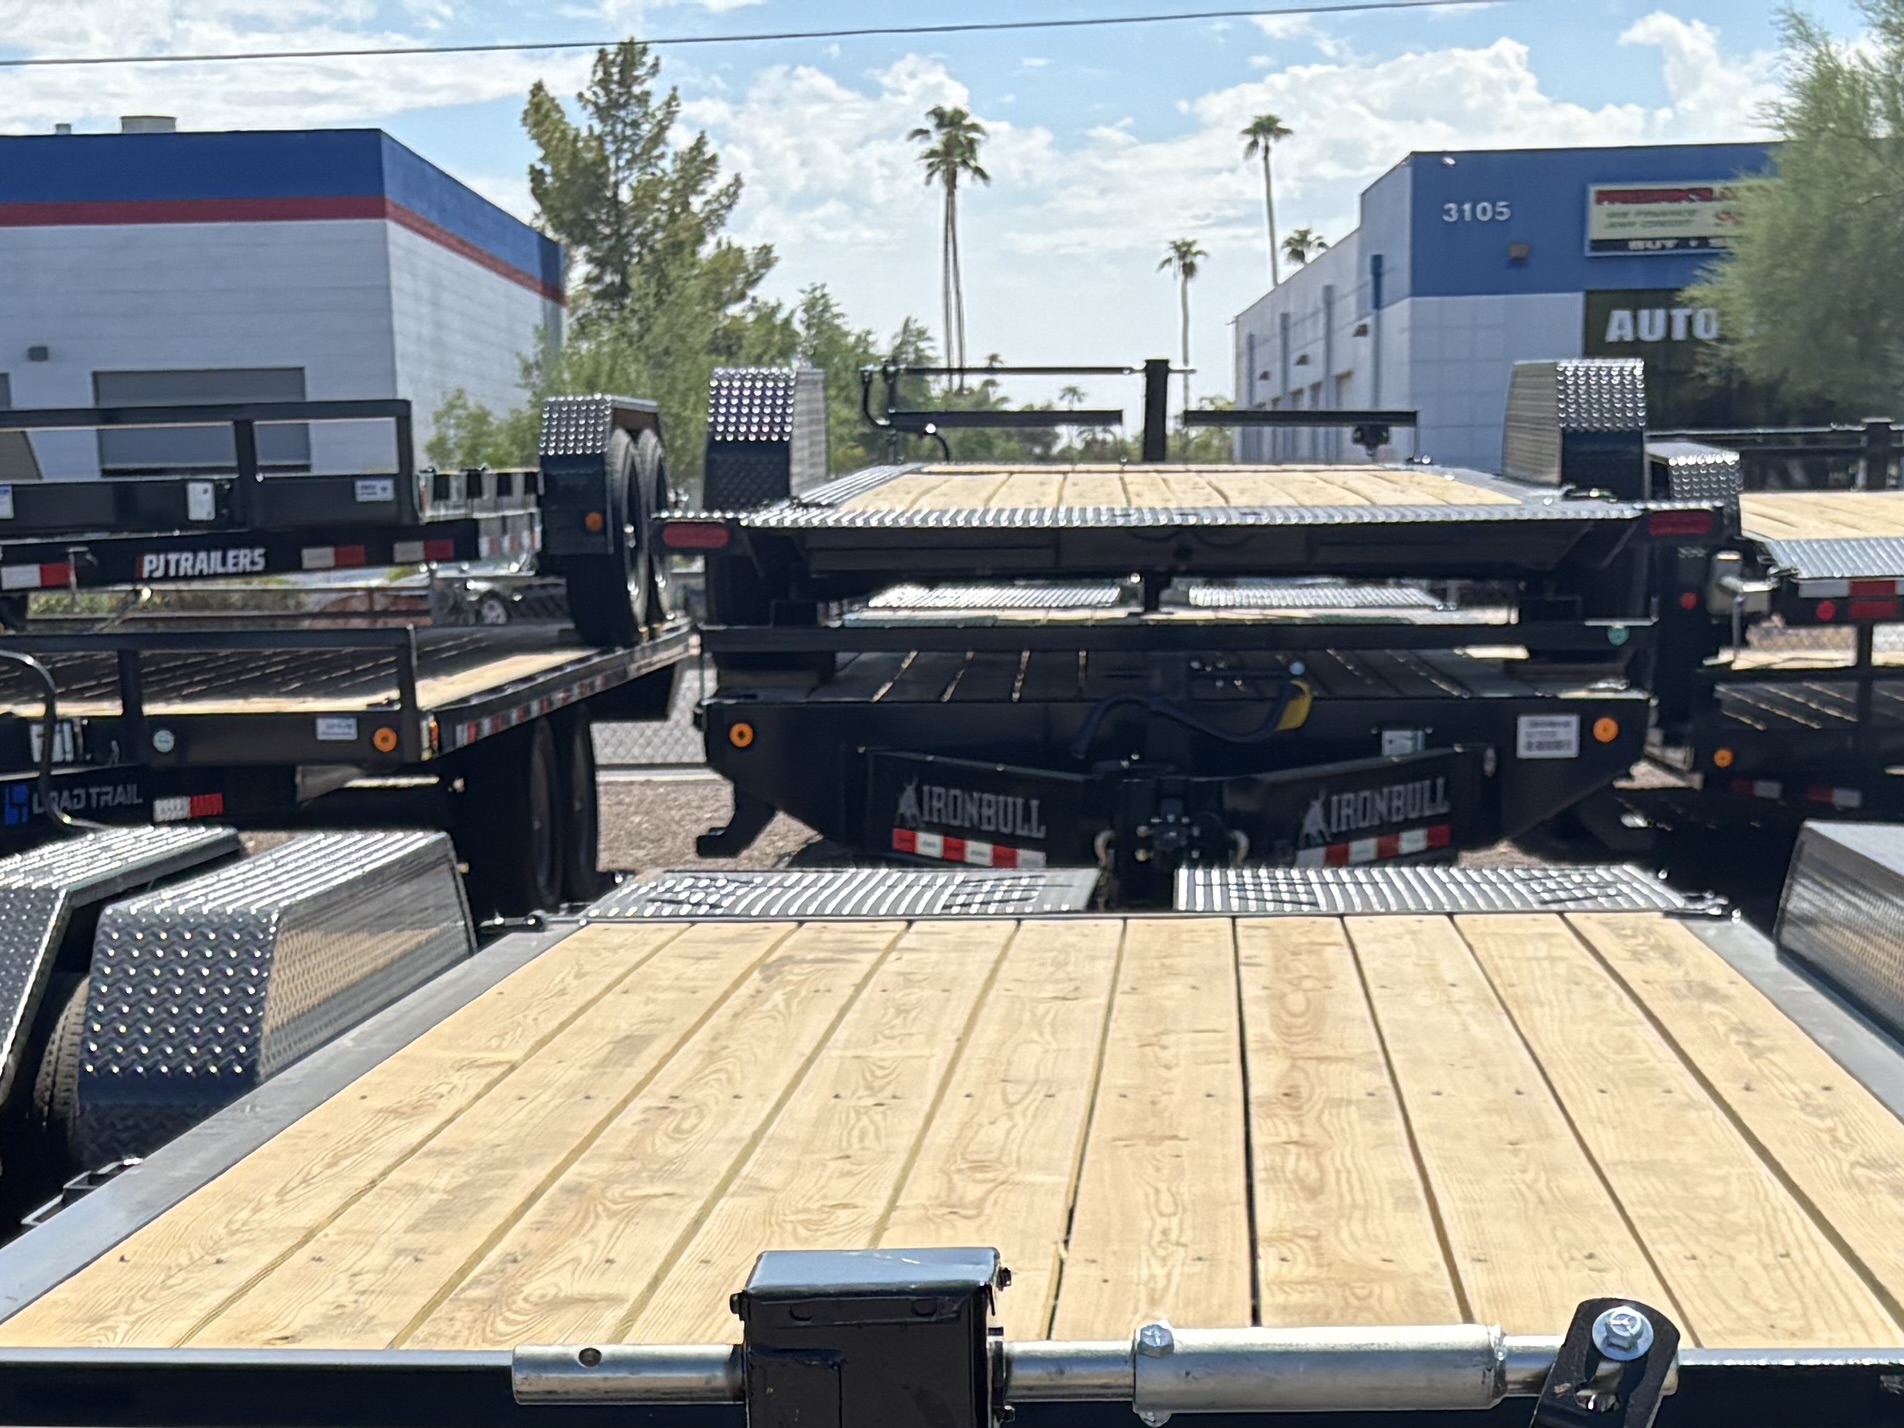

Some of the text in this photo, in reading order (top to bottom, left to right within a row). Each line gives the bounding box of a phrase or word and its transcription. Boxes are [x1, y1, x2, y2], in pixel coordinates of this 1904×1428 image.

[1442, 201, 1512, 223] 3105
[1604, 307, 1720, 343] AUTO
[922, 784, 1046, 839] IRONBULL
[1330, 776, 1450, 834] IRONBULL
